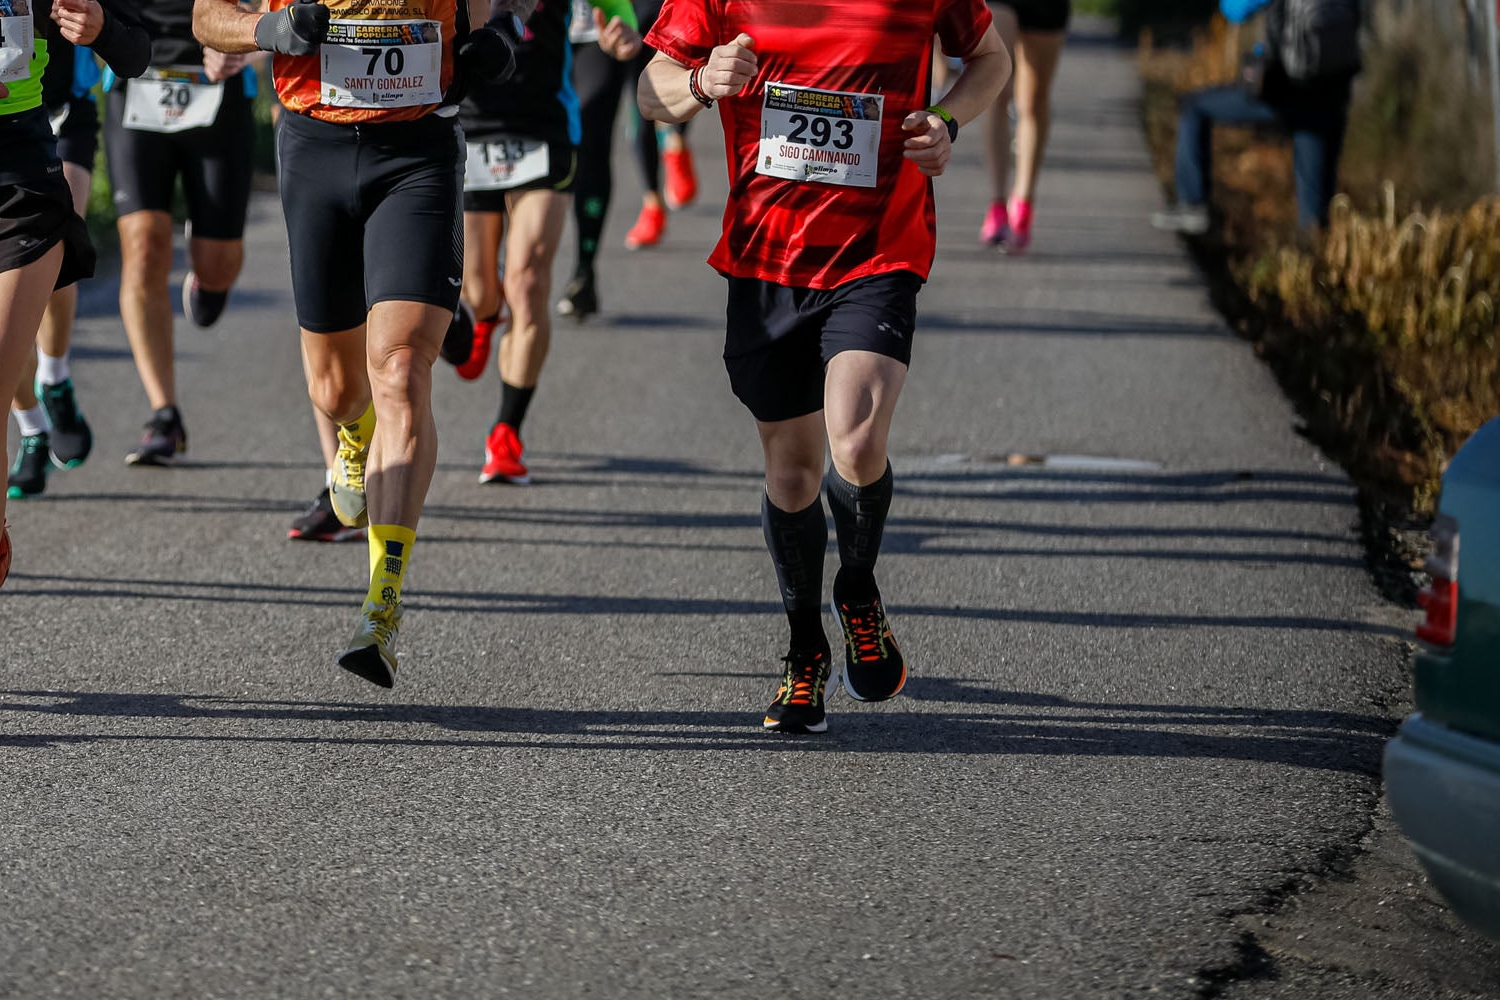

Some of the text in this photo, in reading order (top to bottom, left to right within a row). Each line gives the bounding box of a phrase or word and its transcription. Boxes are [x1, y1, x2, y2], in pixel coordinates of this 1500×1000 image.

[356, 25, 399, 33] CARRERA
[362, 47, 404, 76] 70
[345, 76, 423, 89] SANTY GONZALEZ
[159, 83, 190, 107] 20
[771, 87, 781, 97] 26
[797, 91, 841, 103] CARRERA
[793, 103, 819, 112] Secaderos
[797, 98, 841, 109] POPULAR
[786, 113, 854, 150] 293
[779, 144, 861, 166] SIGO CAMINANDO
[813, 165, 838, 173] olimpo
